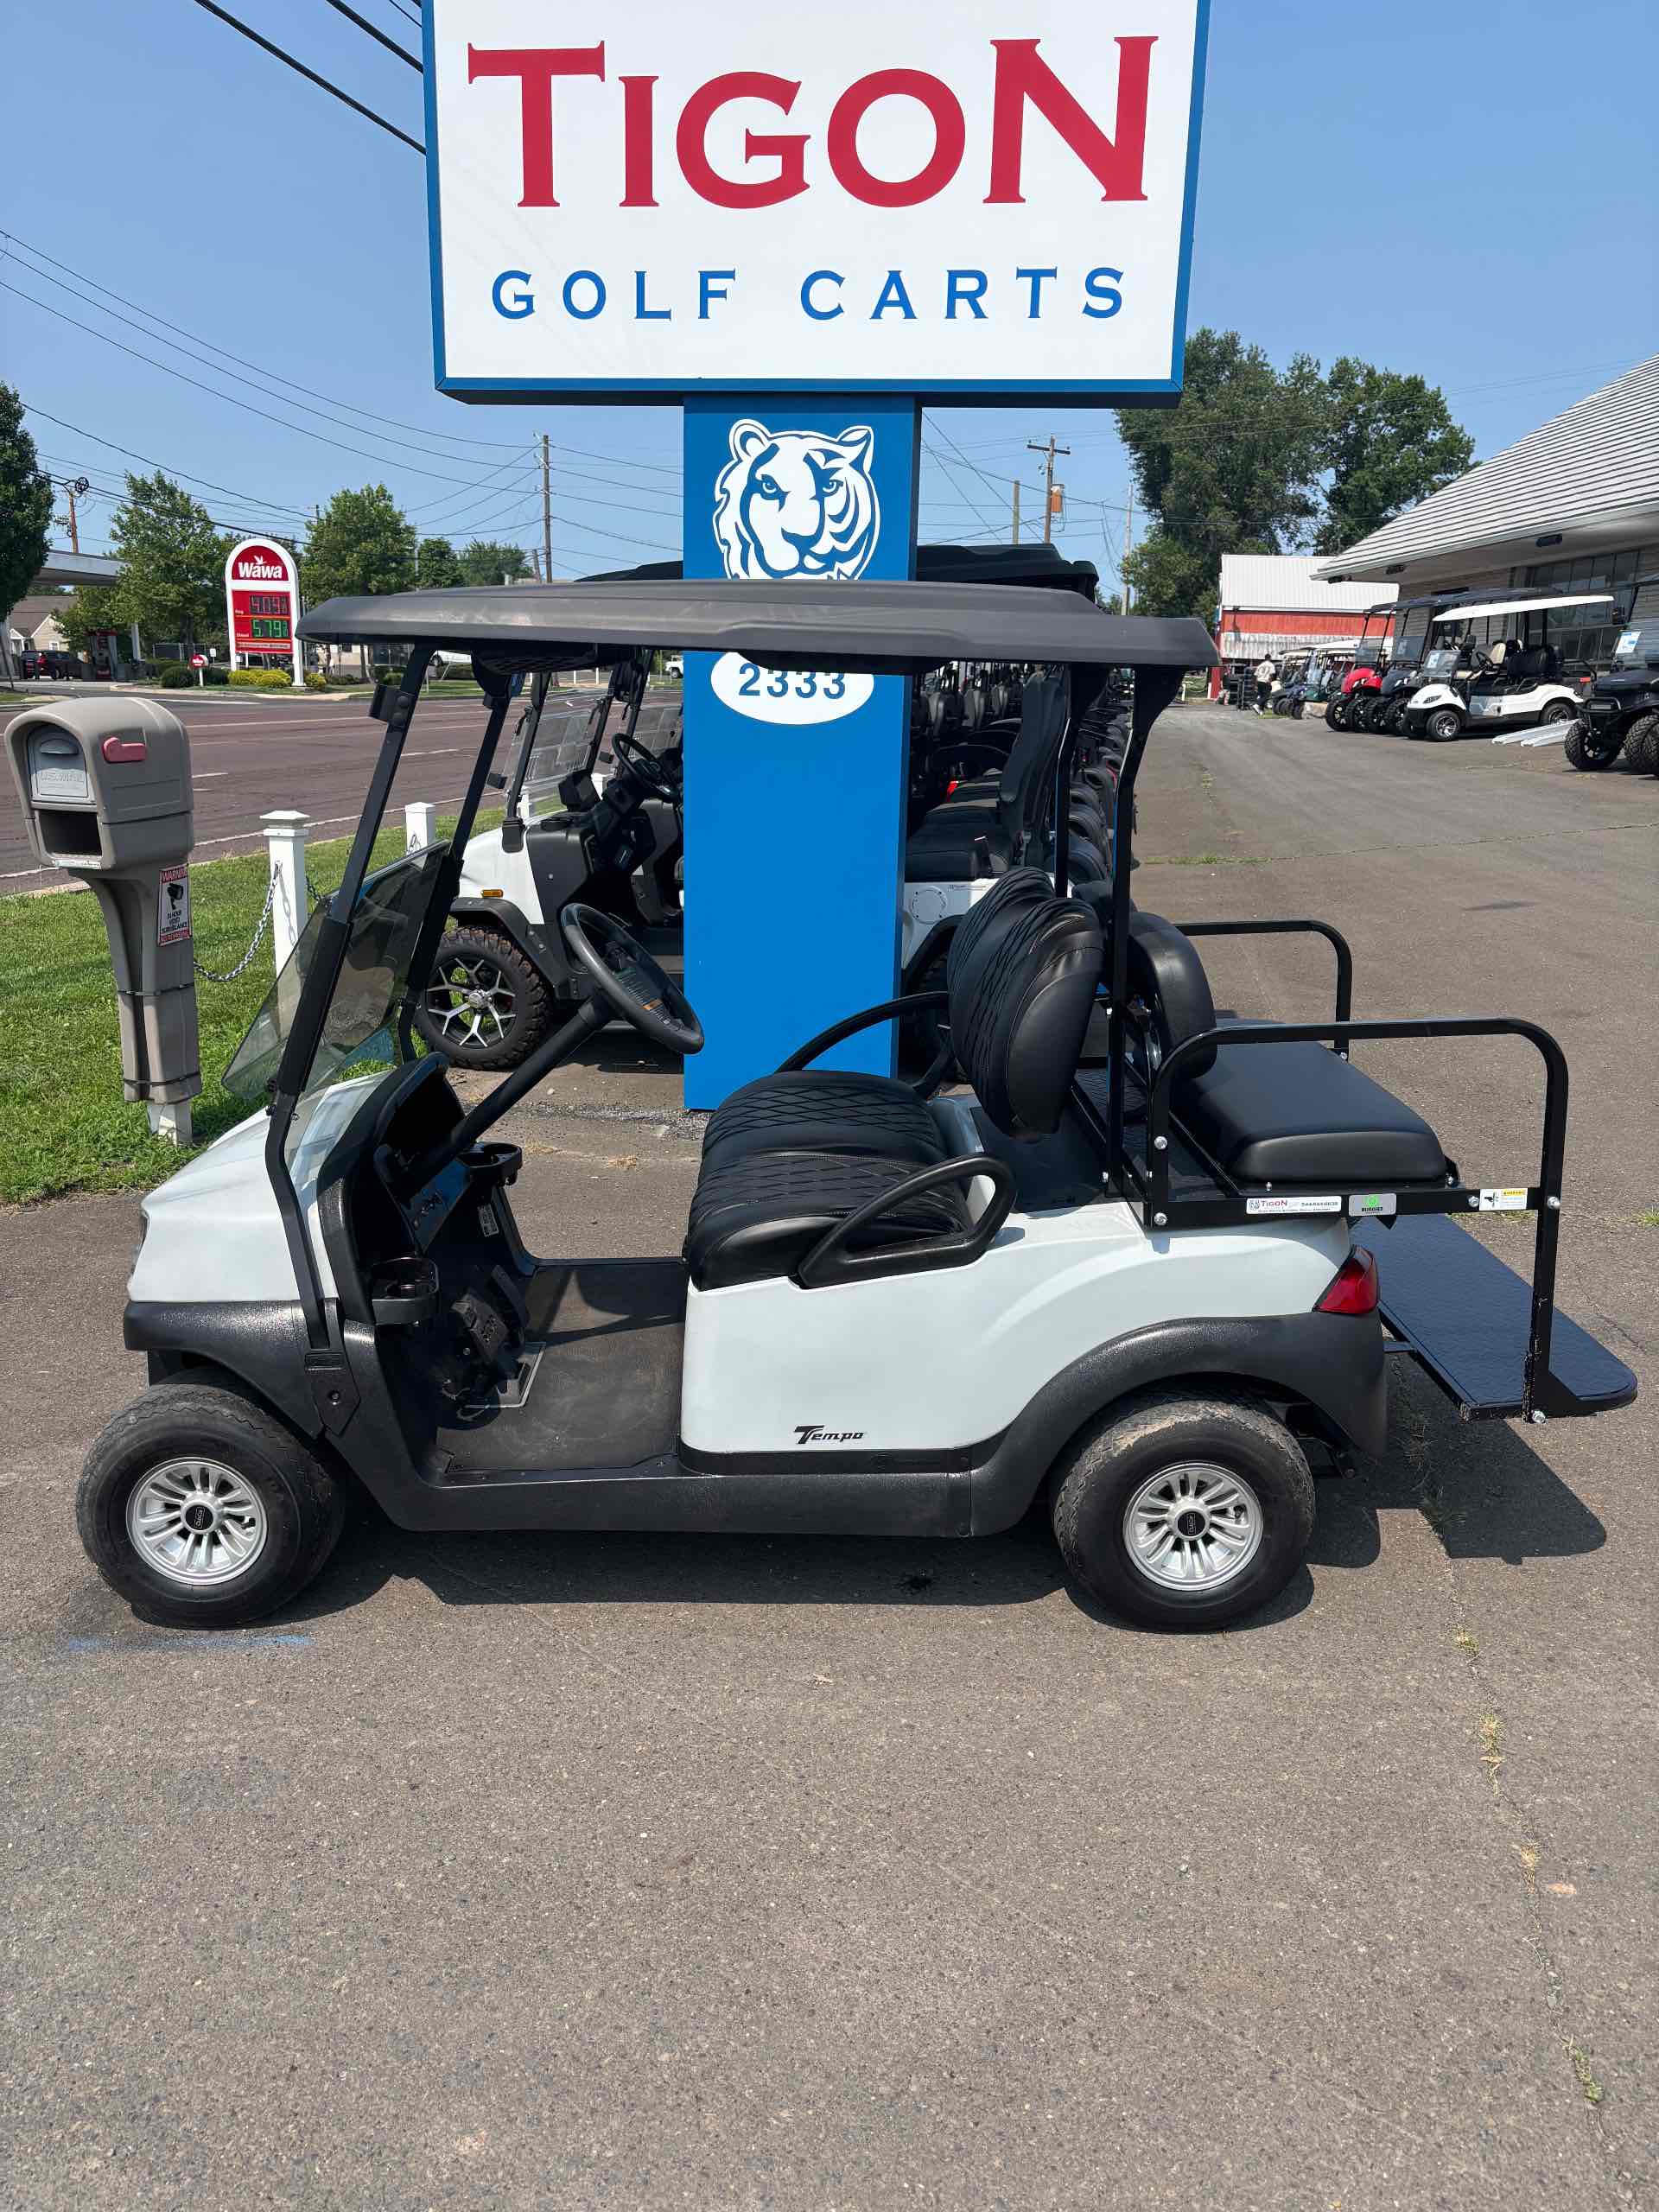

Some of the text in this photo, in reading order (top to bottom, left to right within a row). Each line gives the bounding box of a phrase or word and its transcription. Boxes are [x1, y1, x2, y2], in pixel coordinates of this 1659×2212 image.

[467, 36, 1160, 209] TIGON
[492, 265, 1124, 322] GOLF CARTS
[238, 563, 283, 579] Wawa
[738, 663, 846, 699] 2333
[793, 1425, 865, 1445] Tempo
